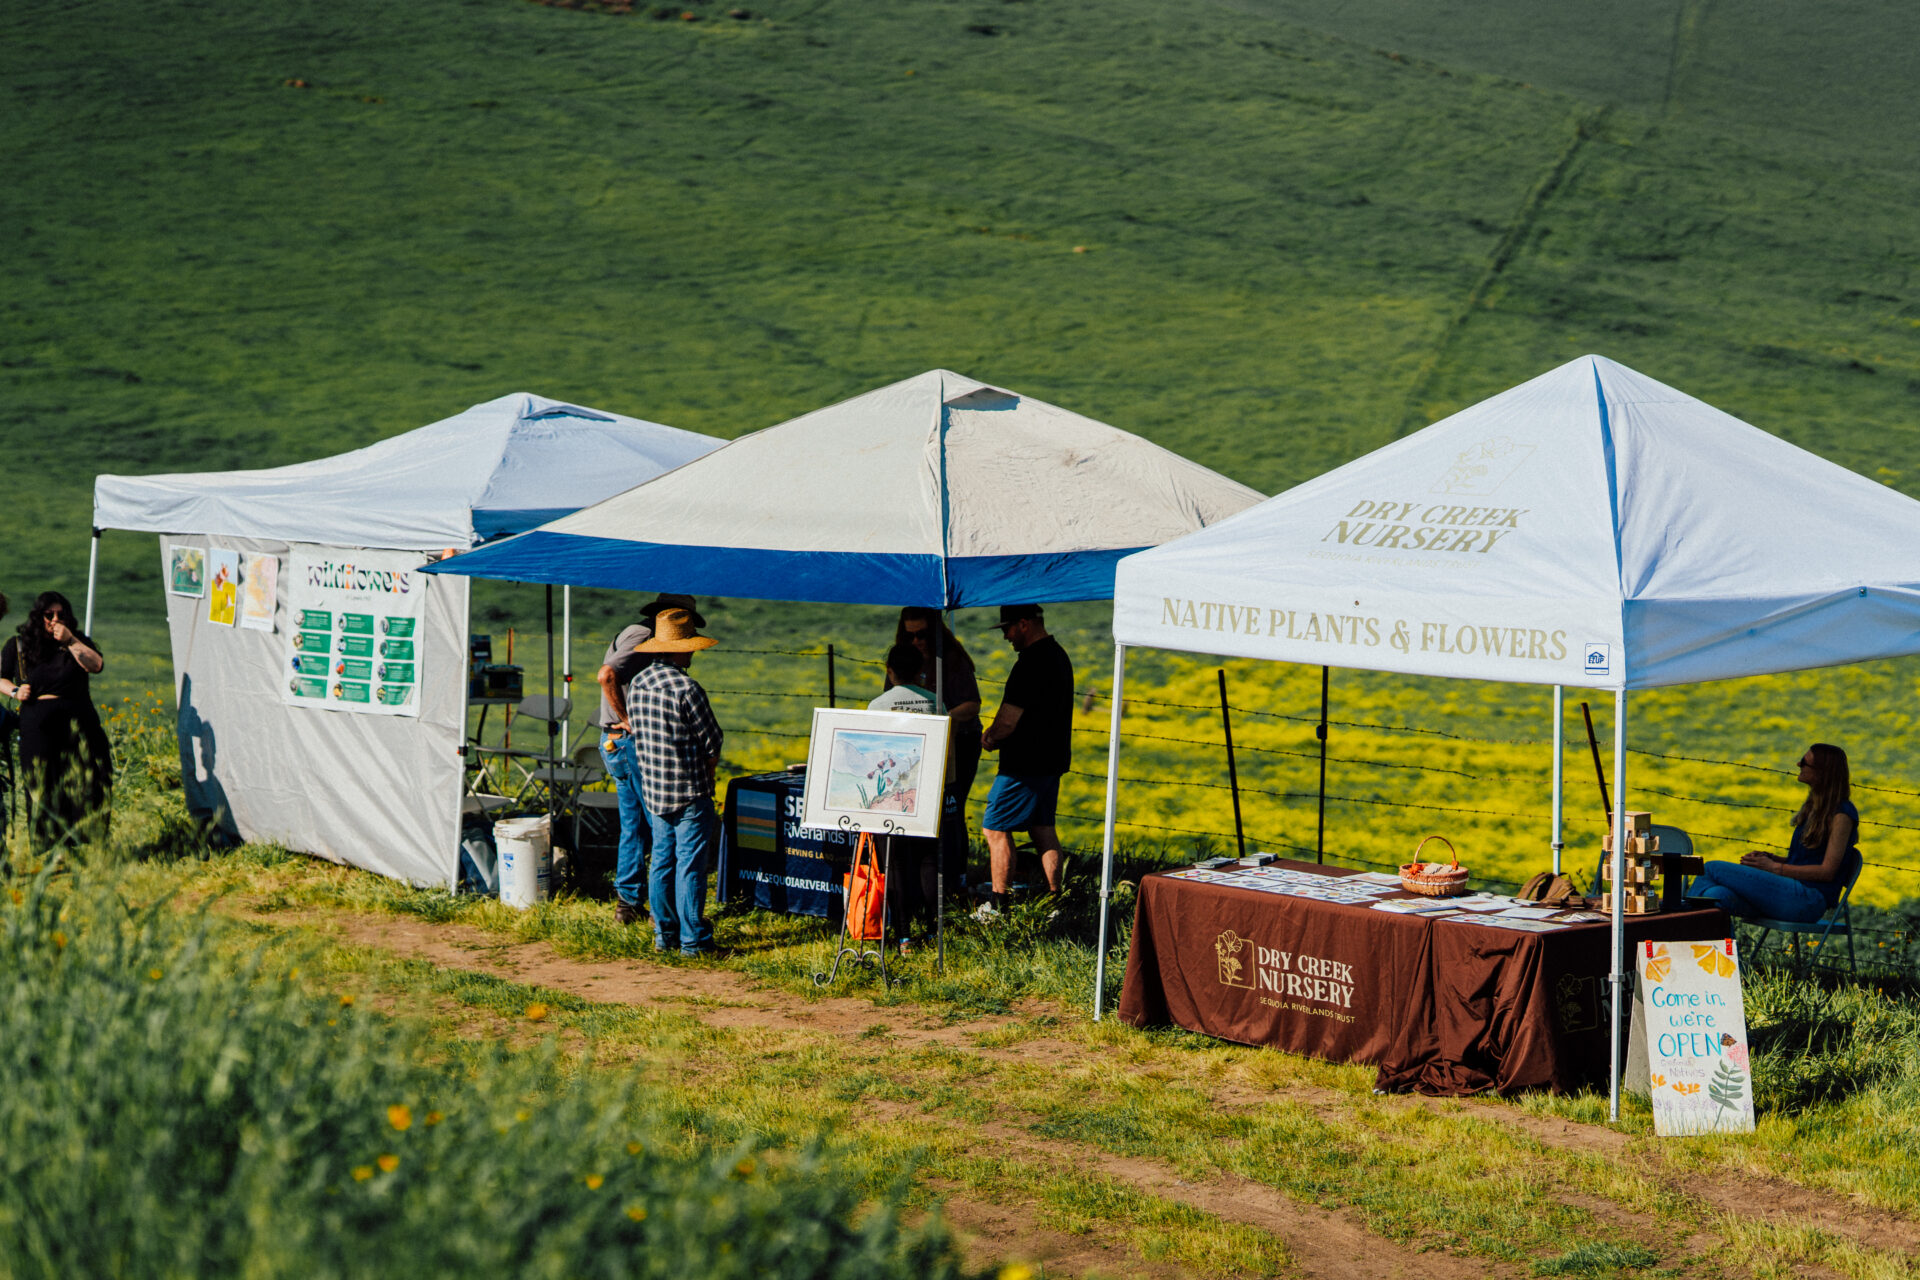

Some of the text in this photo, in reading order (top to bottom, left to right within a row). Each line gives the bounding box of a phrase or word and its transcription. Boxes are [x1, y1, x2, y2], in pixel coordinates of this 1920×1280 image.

[1346, 500, 1530, 528] DRY CREEK
[1321, 520, 1511, 553] NURSERY
[308, 561, 409, 593] wildflowers
[1161, 597, 1567, 661] NATIVE PLANTS & FLOWERS
[783, 821, 845, 845] Riverlands
[1258, 946, 1355, 984] DRY CREEK
[1259, 967, 1355, 1008] NURSERY
[1652, 986, 1701, 1008] Come
[1260, 996, 1356, 1023] SEQUOIA RIVERLANDS TRUST
[1669, 1011, 1717, 1028] we're
[1658, 1032, 1722, 1057] OPEN
